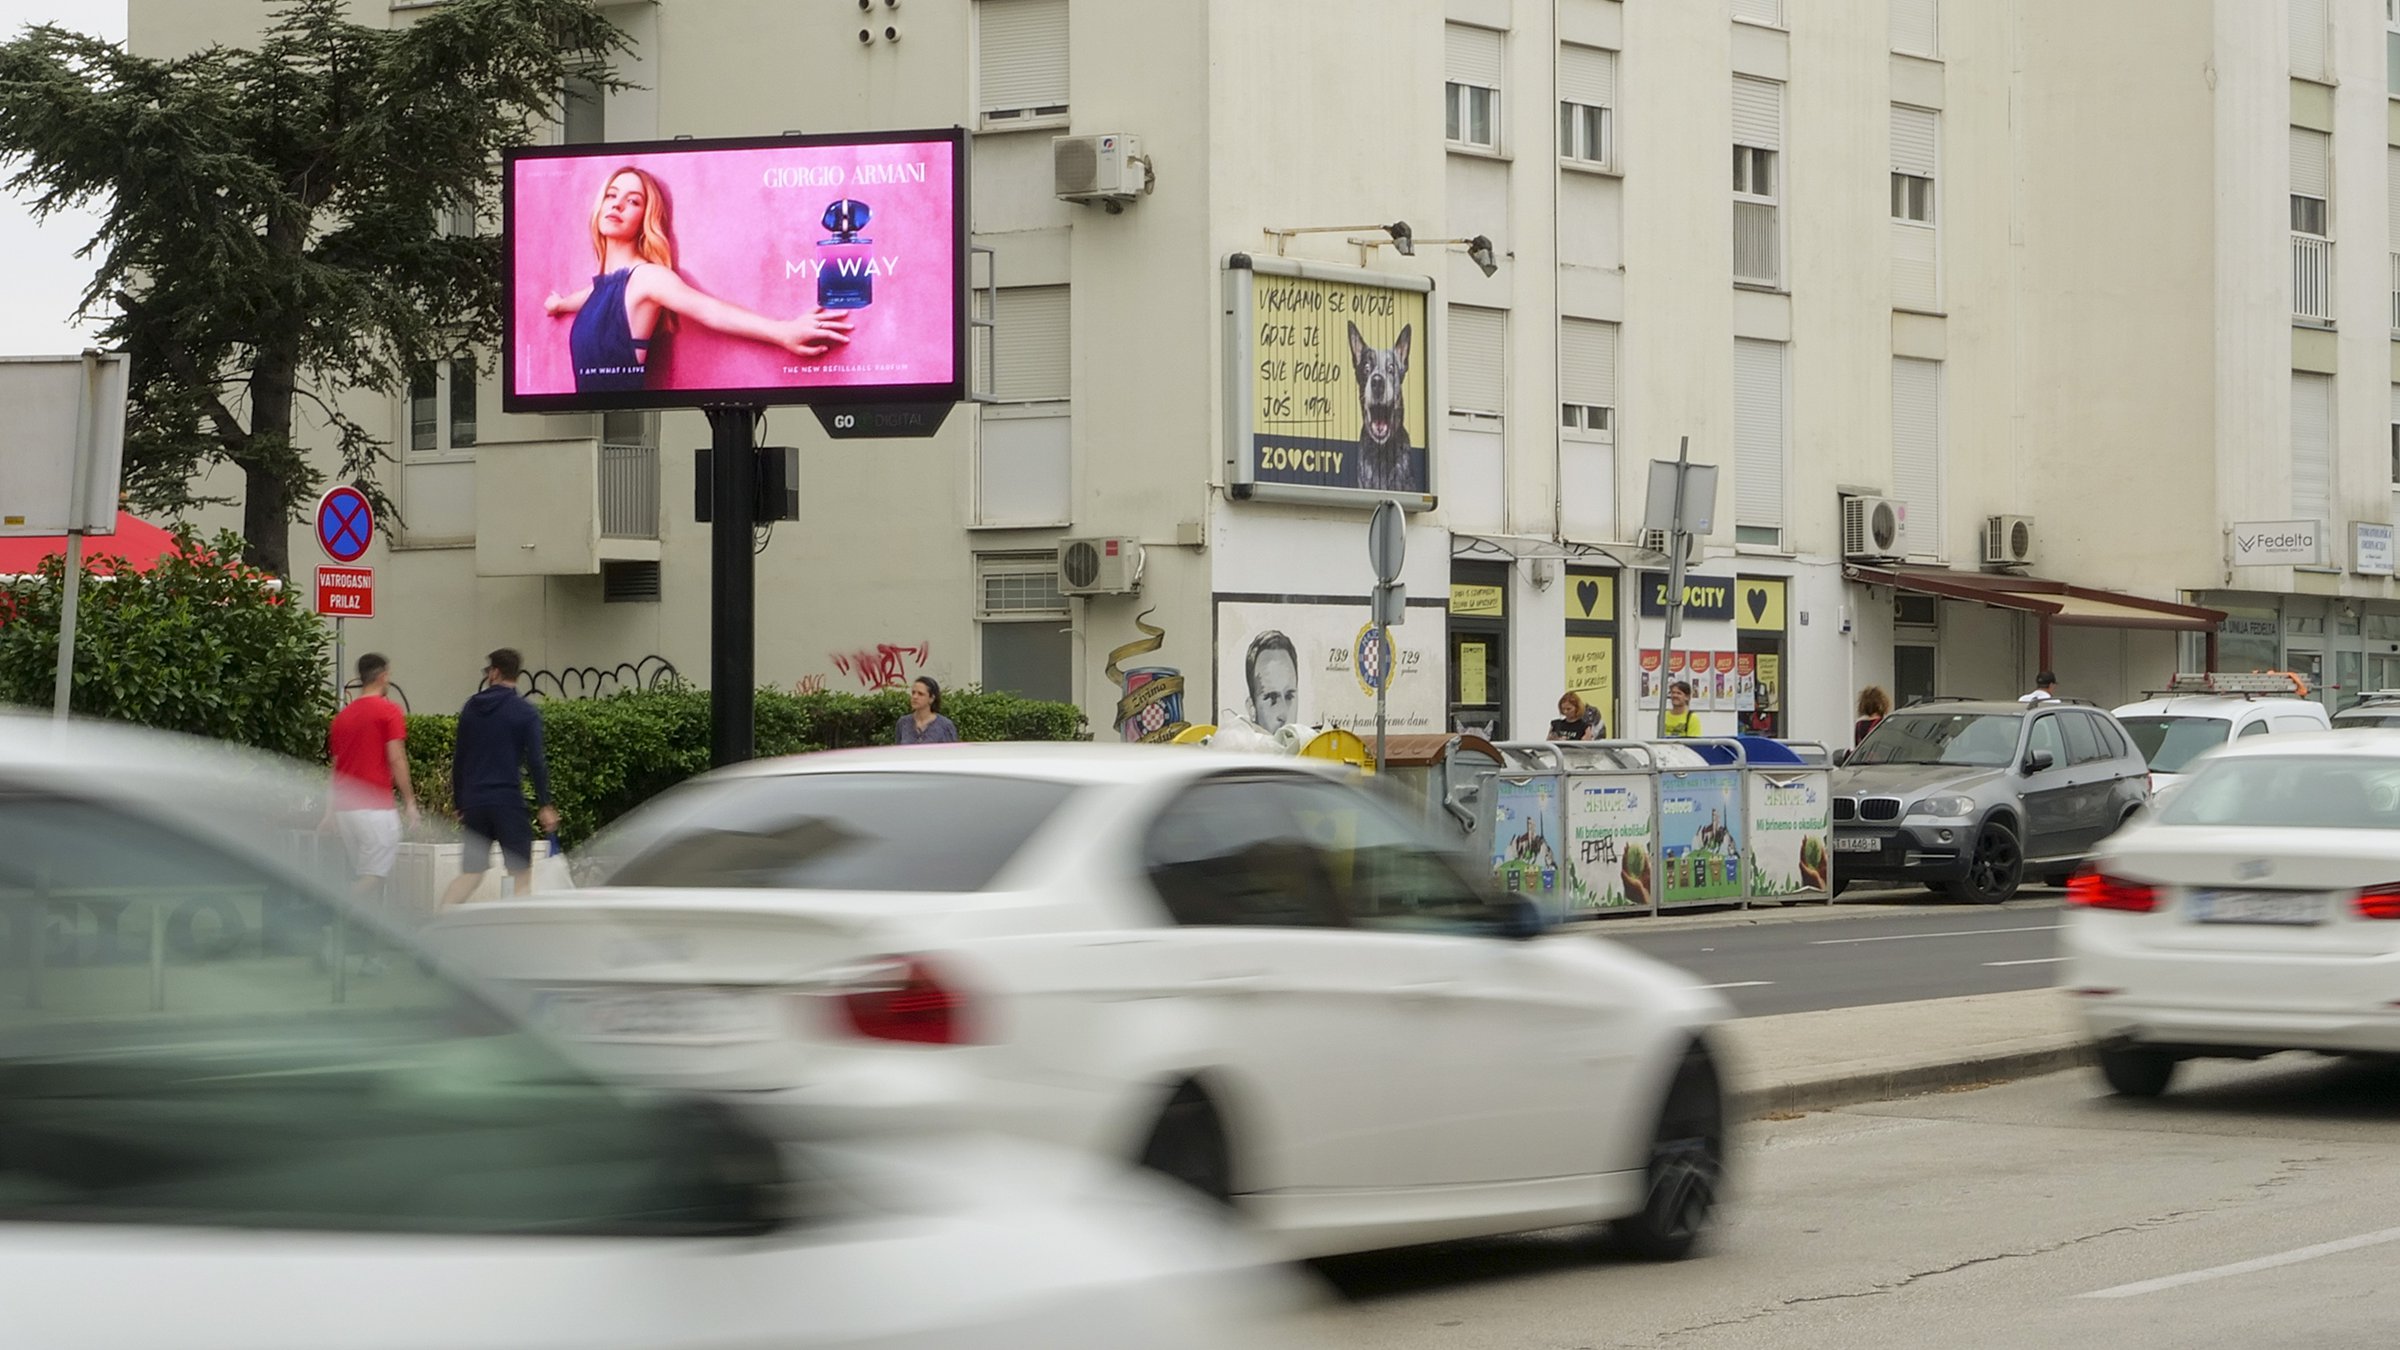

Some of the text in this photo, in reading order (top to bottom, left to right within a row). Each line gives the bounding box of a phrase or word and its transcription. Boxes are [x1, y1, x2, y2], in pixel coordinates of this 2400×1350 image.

[763, 162, 926, 188] GIORGIO ARMANI
[786, 255, 899, 280] MY WAY
[1328, 291, 1346, 313] SE
[1352, 294, 1395, 317] OVDJE
[1260, 322, 1320, 348] GDJE JE
[599, 366, 620, 374] WHAT
[1260, 359, 1287, 382] SVE
[2257, 532, 2313, 548] Fedelta
[320, 573, 371, 589] VATROGASNI
[330, 594, 360, 609] PRILAZ
[1329, 648, 1420, 666] 739 729
[1575, 827, 1583, 839] Mi
[1585, 827, 1612, 839] brinemo
[1756, 819, 1764, 831] Mi
[1766, 818, 1792, 830] brinemo
